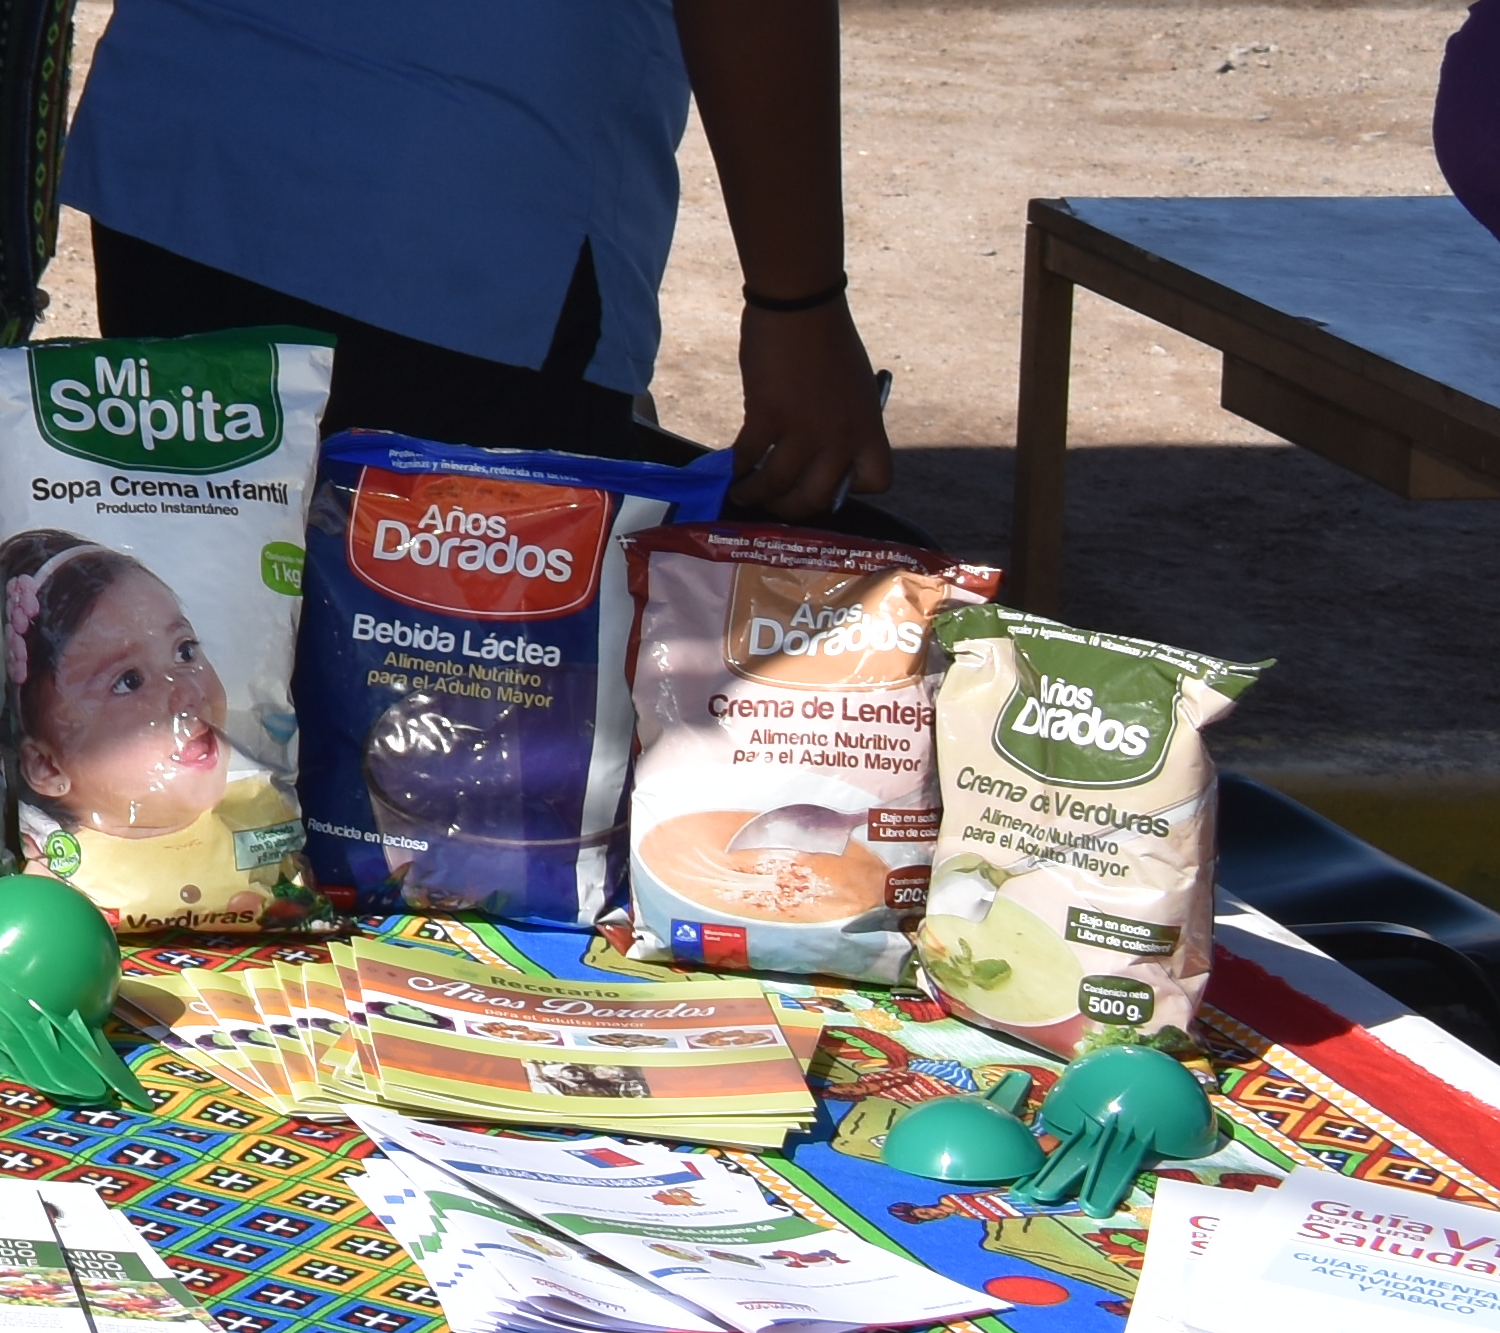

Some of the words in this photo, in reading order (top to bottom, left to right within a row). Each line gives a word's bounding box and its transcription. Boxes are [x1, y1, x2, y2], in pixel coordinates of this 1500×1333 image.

[94, 355, 150, 398] Mi
[50, 378, 266, 451] Sopita
[31, 477, 102, 504] Sopa
[109, 475, 200, 499] Crema
[207, 479, 289, 506] Infantil
[96, 501, 158, 515] Producto
[161, 502, 239, 517] Instantáneo
[417, 504, 507, 539] Años
[372, 519, 574, 583] Dorados
[790, 603, 864, 630] Años
[352, 612, 456, 654] Bebida
[461, 629, 562, 668] Láctea
[748, 614, 924, 657] Dorados
[383, 651, 464, 677] Alimento
[468, 663, 542, 688] Nutritivo
[367, 669, 408, 687] para
[434, 676, 492, 701] Adulto
[495, 684, 554, 709] Mayor
[707, 694, 795, 719] Crema
[1011, 696, 1150, 756] Dorados
[834, 731, 911, 751] Nutritivo
[799, 750, 859, 768] Adulto
[864, 751, 922, 775] Mayor
[955, 766, 1028, 803] Crema
[1053, 791, 1170, 838] Verduras
[306, 817, 362, 840] Reducida
[382, 832, 429, 852] lactosa
[1072, 851, 1130, 878] Mayor
[126, 908, 255, 932] Verduras
[1079, 912, 1103, 929] Bajo
[1076, 928, 1105, 944] Libre
[489, 976, 620, 1000] Recetario
[534, 998, 716, 1020] Dorados
[1087, 995, 1125, 1016] 500
[1310, 1199, 1435, 1236] Guía
[1292, 1251, 1370, 1273] GUÍAS
[1310, 1266, 1447, 1299] ACTIVIDAD
[1380, 1288, 1476, 1316] TABACO
